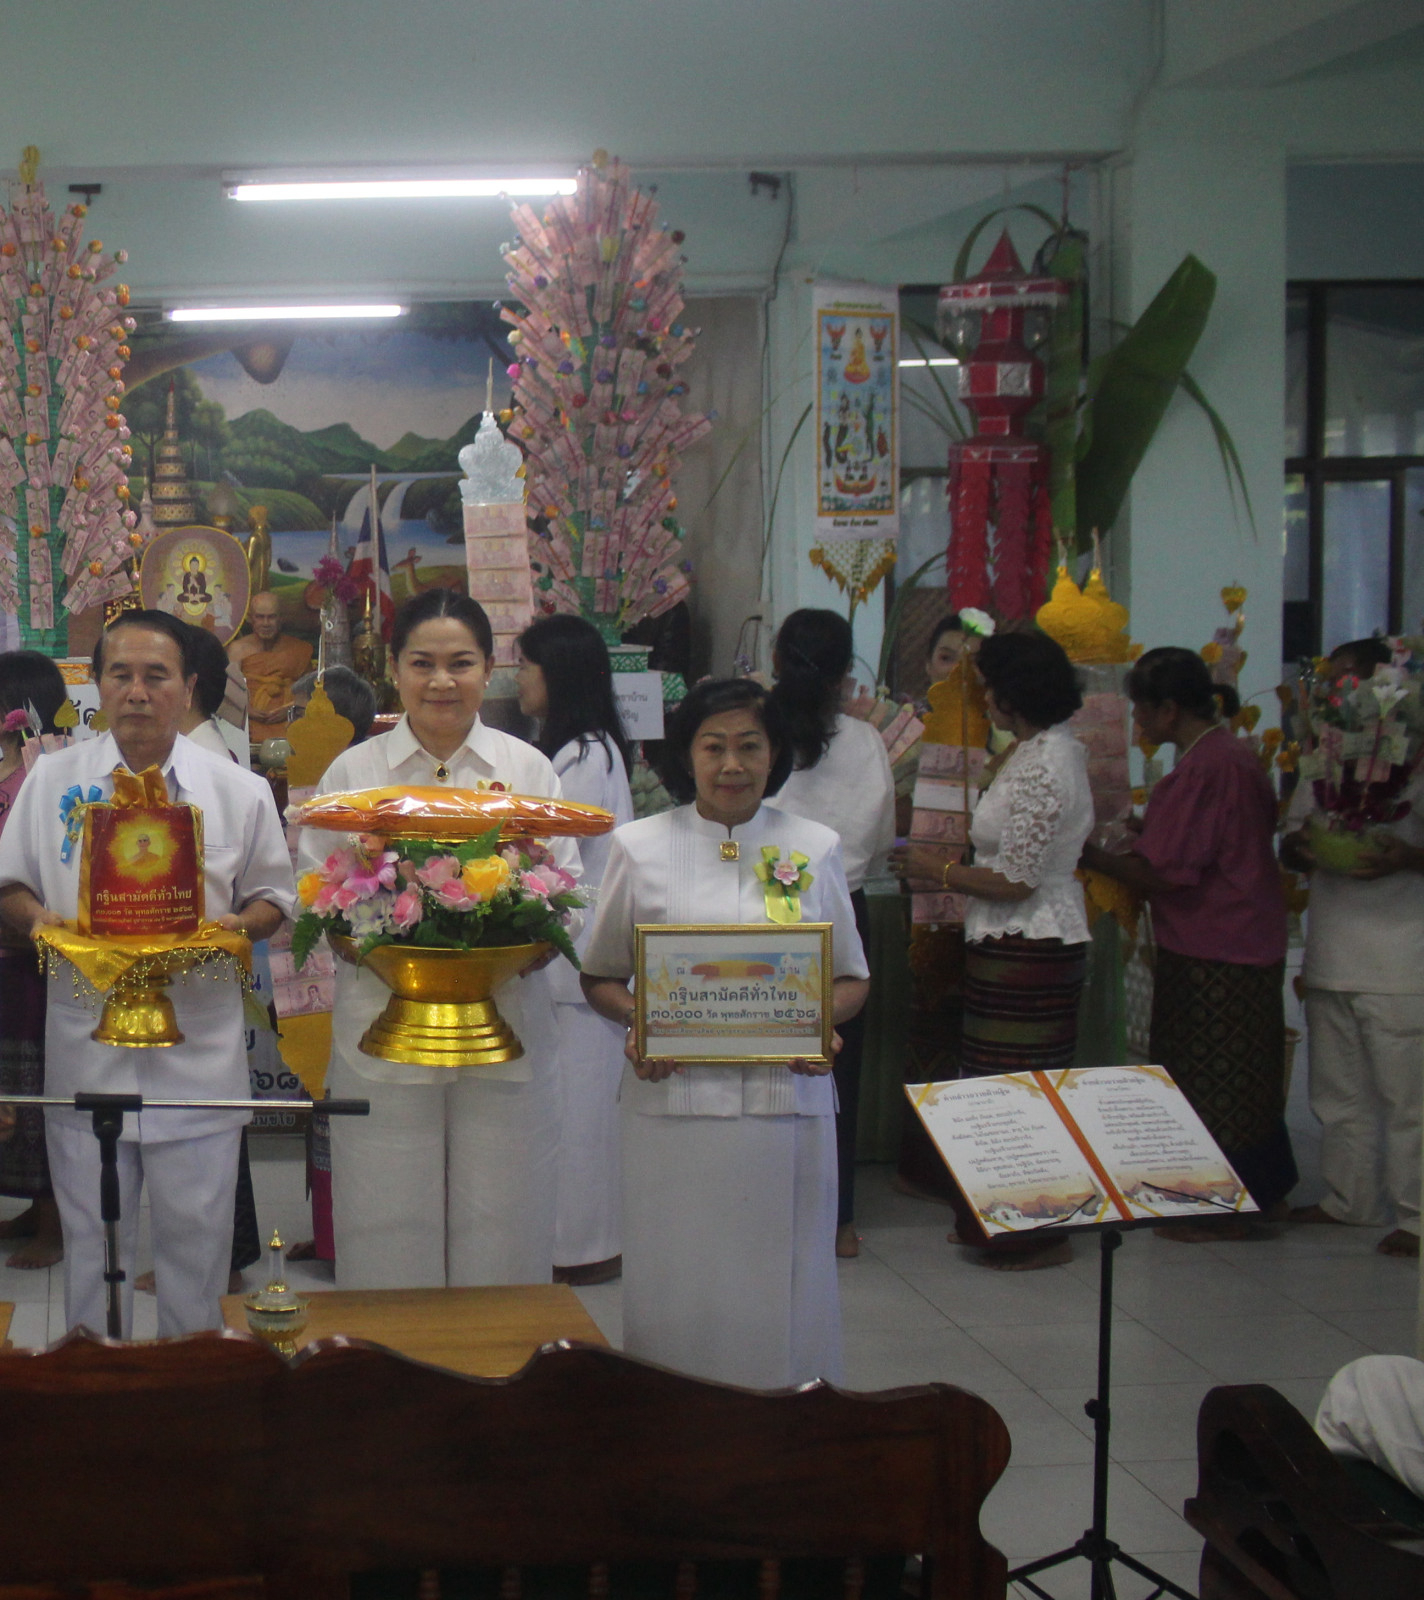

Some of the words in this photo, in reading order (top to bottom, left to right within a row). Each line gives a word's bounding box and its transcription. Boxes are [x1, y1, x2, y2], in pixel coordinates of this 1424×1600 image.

[668, 983, 798, 1006] กฐินสามัคคีทั่วไทย
[650, 1009, 703, 1021] ๓๐,๐๐๐
[773, 1008, 817, 1020] ๒๕๖๘
